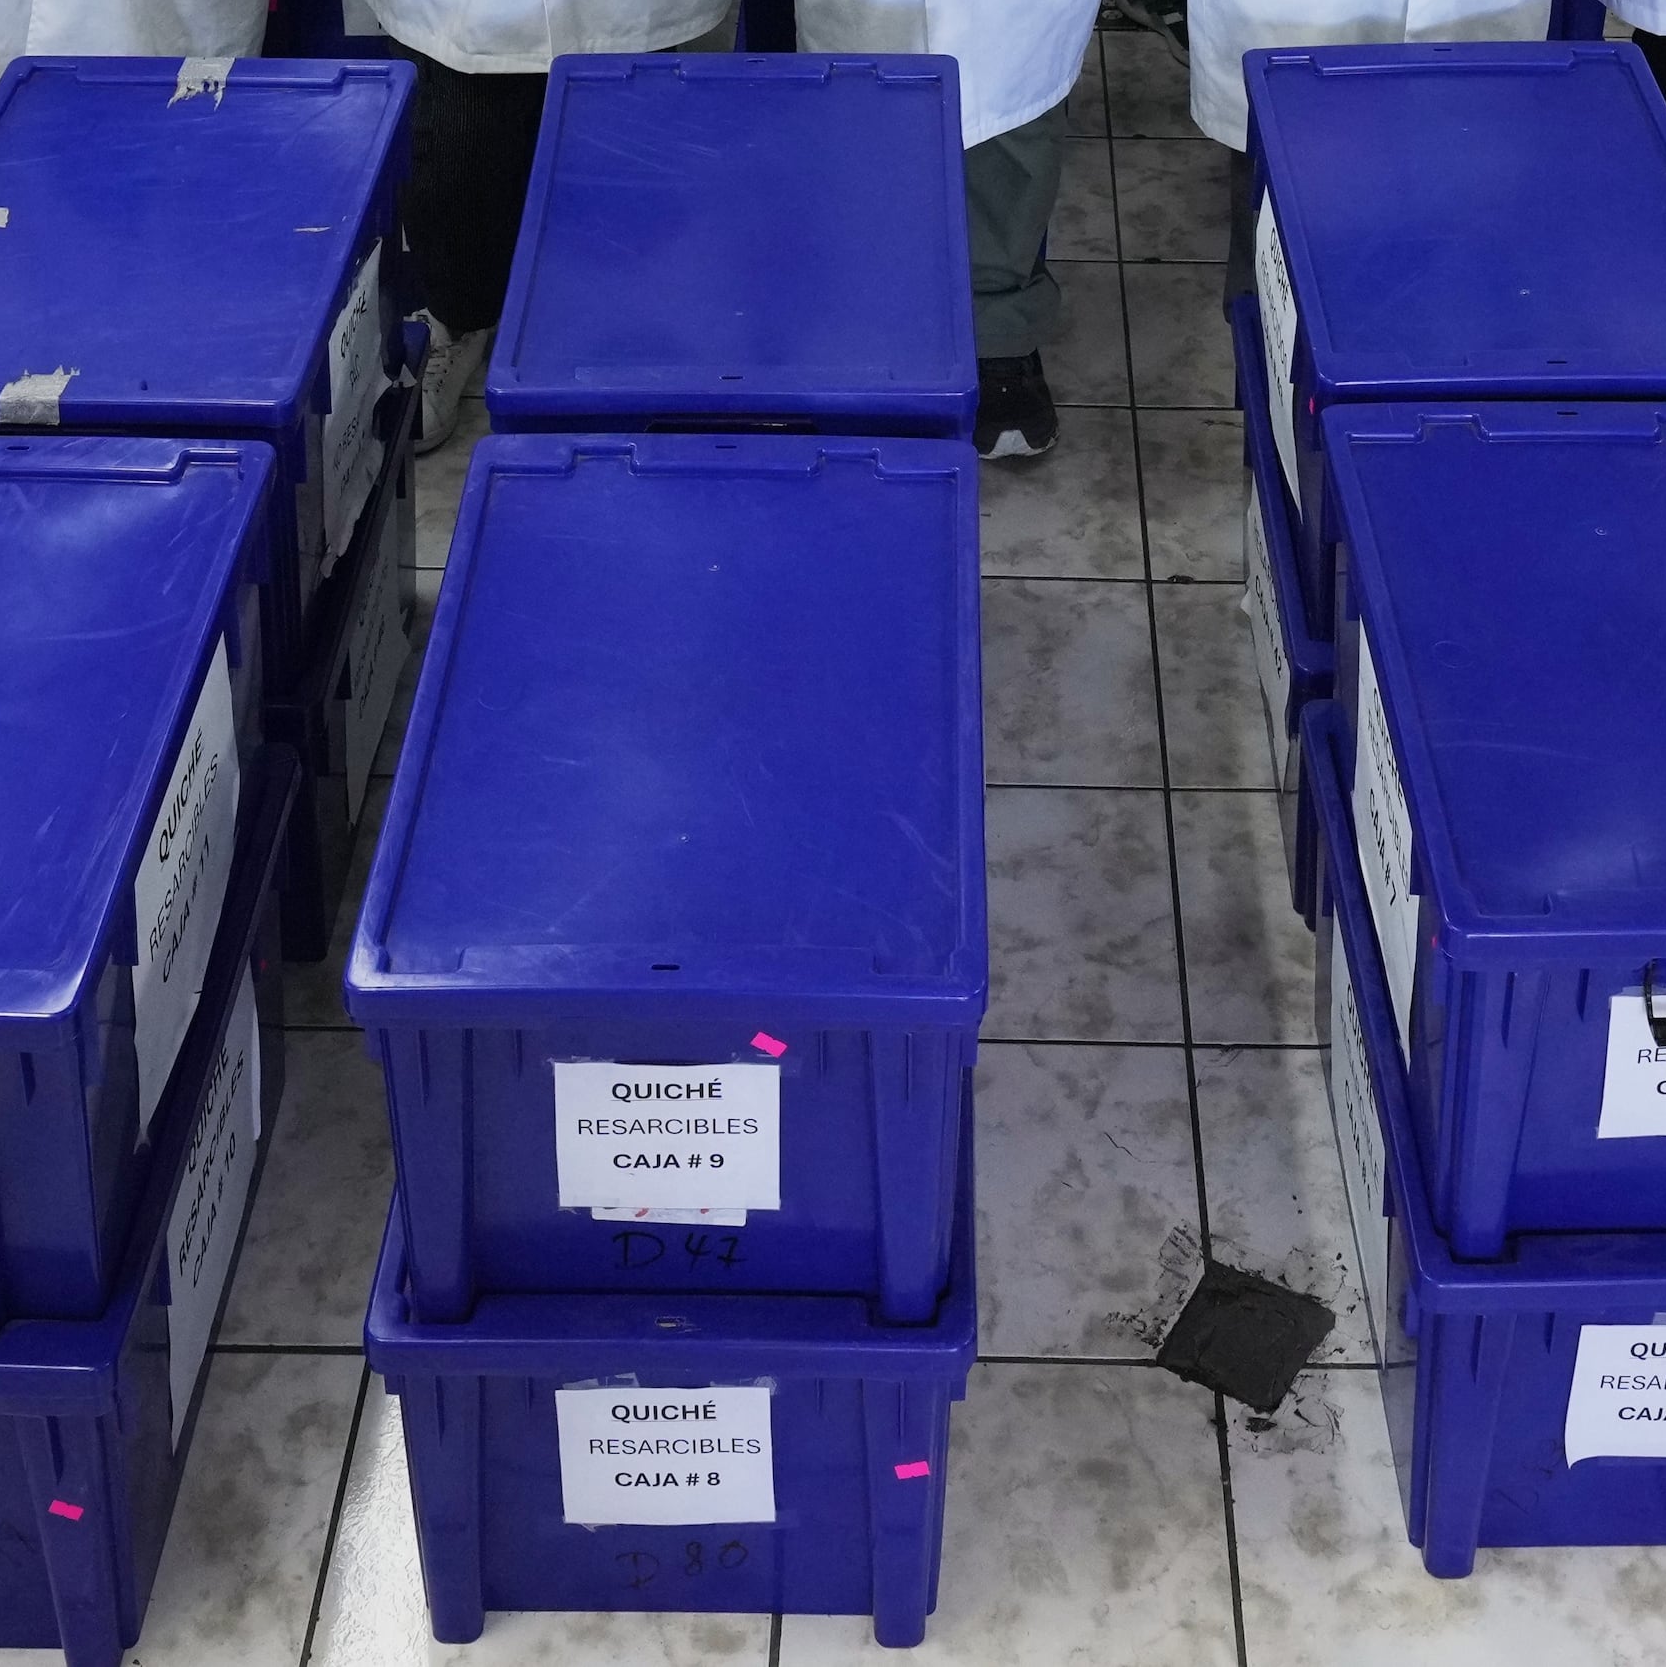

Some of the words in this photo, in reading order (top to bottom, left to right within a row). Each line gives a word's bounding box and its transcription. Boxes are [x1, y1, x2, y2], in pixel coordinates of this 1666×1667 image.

[611, 1078, 723, 1103] QUICHÉ
[577, 1117, 759, 1135] RESARCIBLES
[613, 1154, 680, 1169] CAJA
[688, 1154, 703, 1169] #
[709, 1153, 724, 1169] 9
[611, 1400, 717, 1423] QUICHÉ
[588, 1438, 761, 1455] RESARCIBLES
[614, 1472, 679, 1487] CAJA
[685, 1472, 700, 1486] #
[706, 1472, 721, 1487] 8
